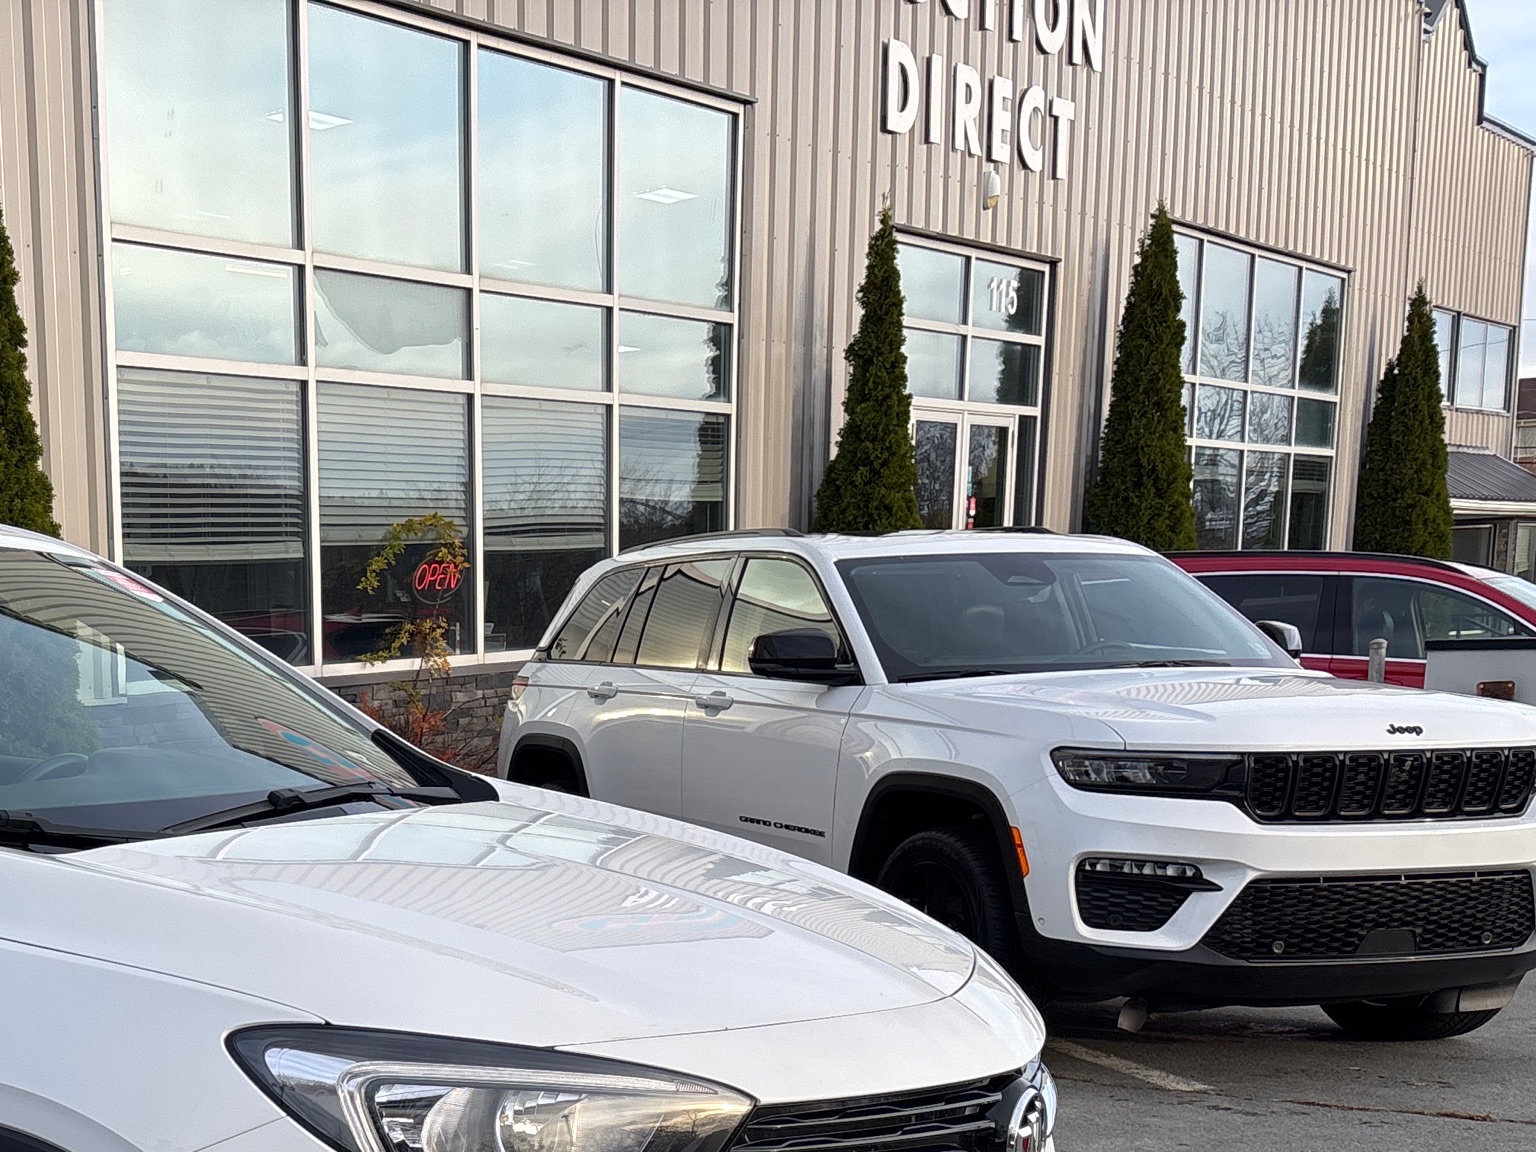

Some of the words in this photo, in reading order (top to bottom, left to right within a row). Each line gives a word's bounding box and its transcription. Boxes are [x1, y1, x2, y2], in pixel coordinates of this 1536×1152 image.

[886, 37, 1076, 180] DIRECT
[989, 276, 1018, 315] 115
[415, 563, 460, 590] OPEN
[1385, 723, 1424, 737] Jeep
[738, 815, 772, 827] GRAND
[773, 821, 826, 838] CHEROKEE
